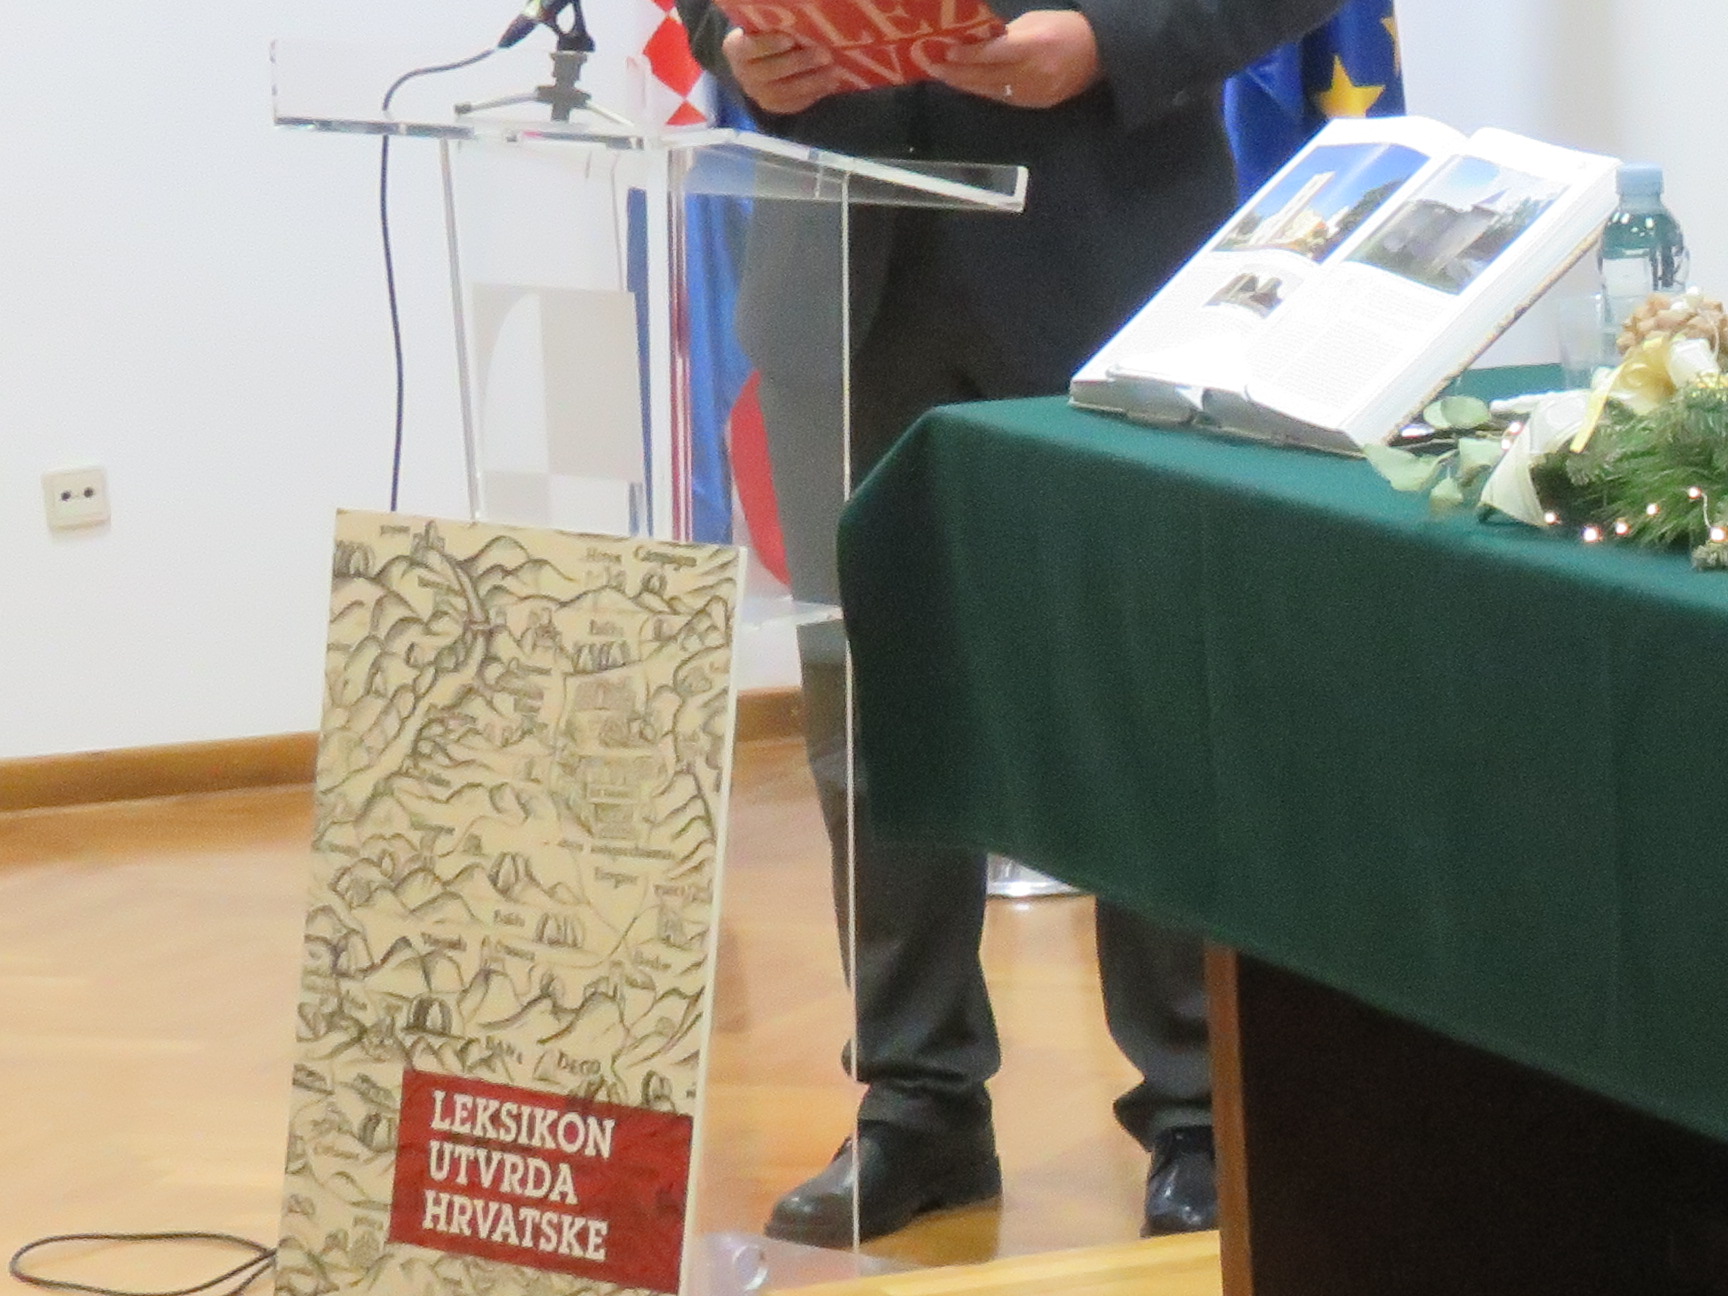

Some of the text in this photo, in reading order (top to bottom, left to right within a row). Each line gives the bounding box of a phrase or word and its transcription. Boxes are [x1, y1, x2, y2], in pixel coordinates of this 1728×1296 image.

[429, 1089, 616, 1159] LEKSIKON
[428, 1140, 580, 1205] UTVRDA
[421, 1189, 609, 1261] HRVATSKE
